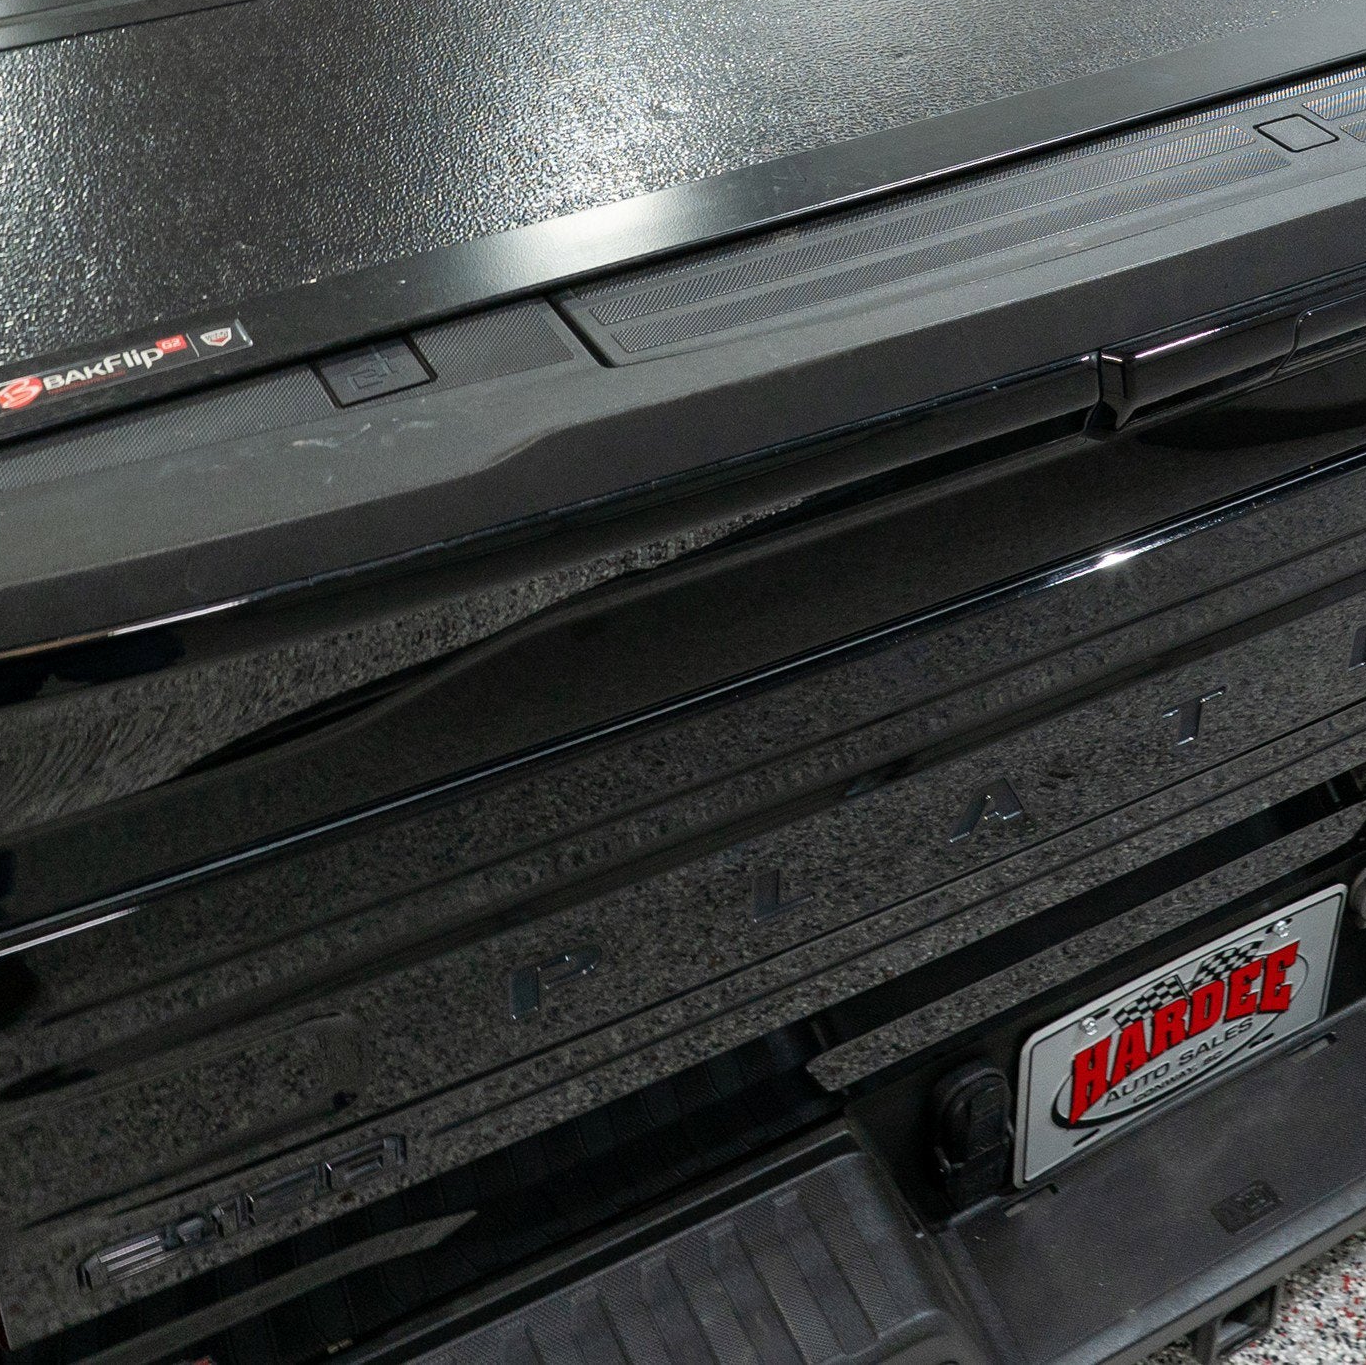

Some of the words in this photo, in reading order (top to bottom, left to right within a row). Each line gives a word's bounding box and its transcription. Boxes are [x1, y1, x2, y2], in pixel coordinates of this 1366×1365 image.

[1069, 938, 1301, 1126] HARDEE
[1104, 1063, 1170, 1108] AUTO
[1178, 1017, 1254, 1067] SALES
